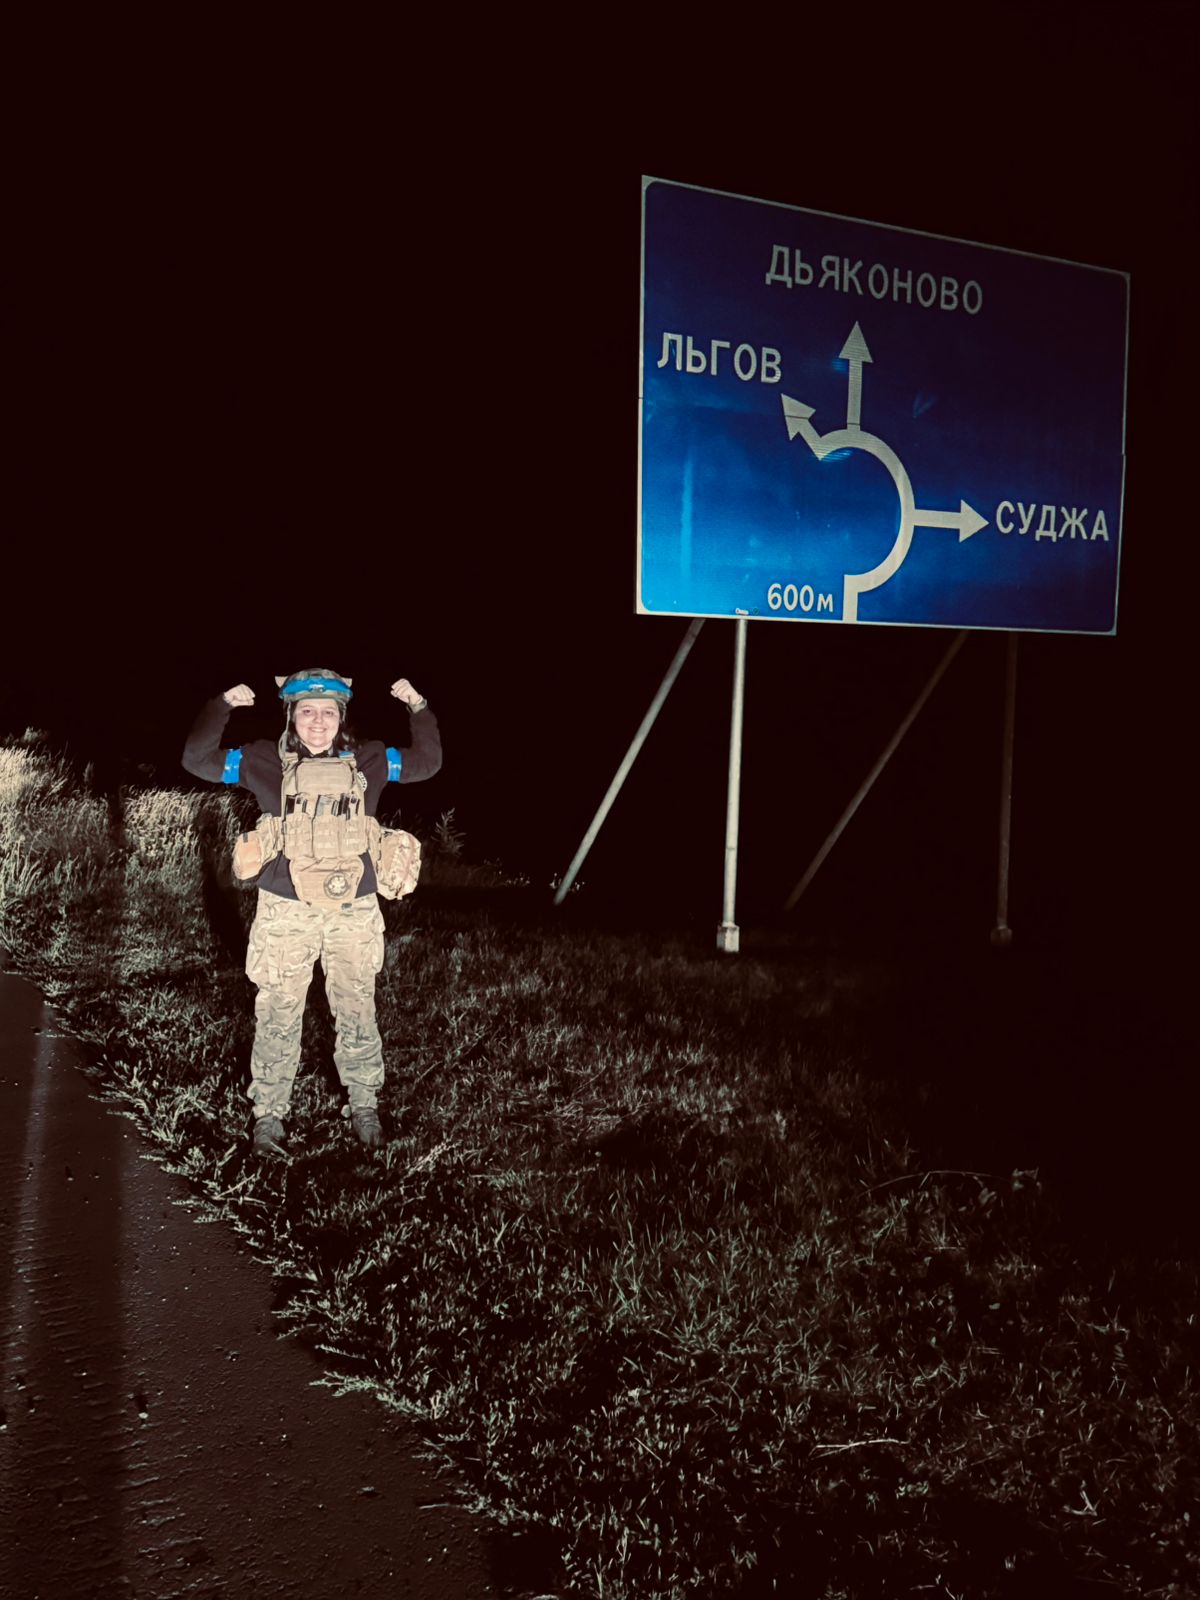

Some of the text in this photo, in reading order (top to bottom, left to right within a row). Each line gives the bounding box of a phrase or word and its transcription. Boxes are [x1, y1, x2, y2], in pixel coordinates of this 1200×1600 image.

[765, 244, 983, 315] ДЬЯКОНОВО
[657, 332, 782, 384] ЛЬГОВ
[995, 501, 1110, 542] СУДЖА
